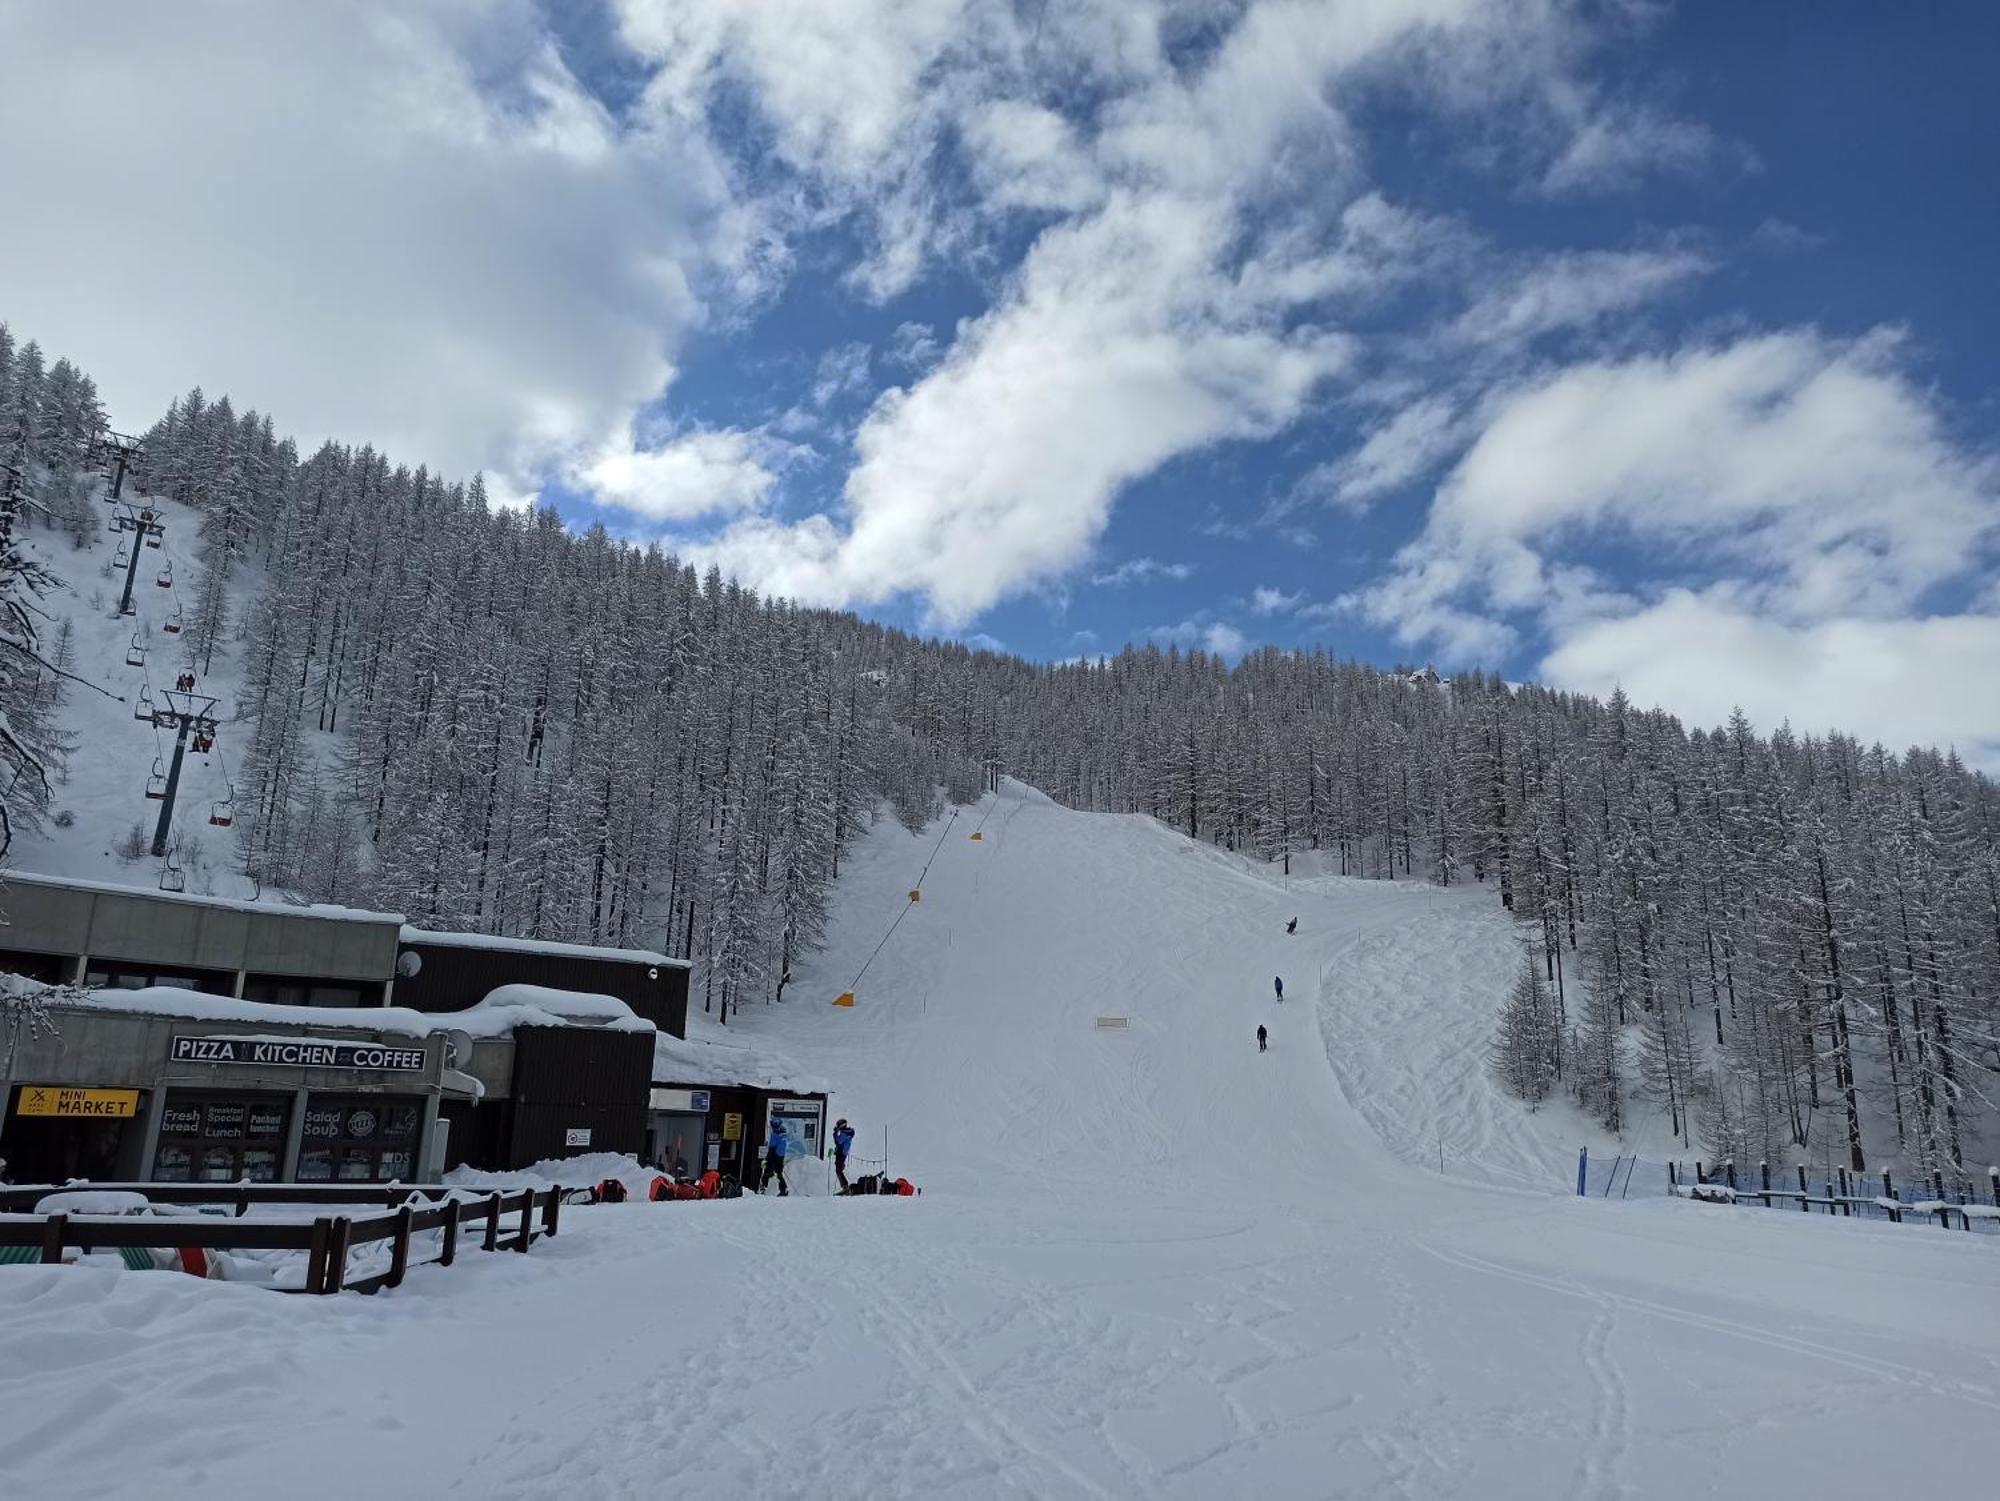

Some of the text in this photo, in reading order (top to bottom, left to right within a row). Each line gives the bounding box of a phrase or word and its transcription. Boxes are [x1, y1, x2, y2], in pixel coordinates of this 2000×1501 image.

[178, 1040, 421, 1068] PIZZA KITCHEN COFFEE
[59, 1091, 86, 1100] MINI
[57, 1101, 128, 1114] MARKET
[164, 1109, 200, 1121] Fresh
[207, 1114, 244, 1123] Special
[305, 1111, 341, 1122] Salad
[162, 1121, 199, 1132] bread
[205, 1127, 241, 1137] Lunch
[304, 1123, 338, 1137] Soup
